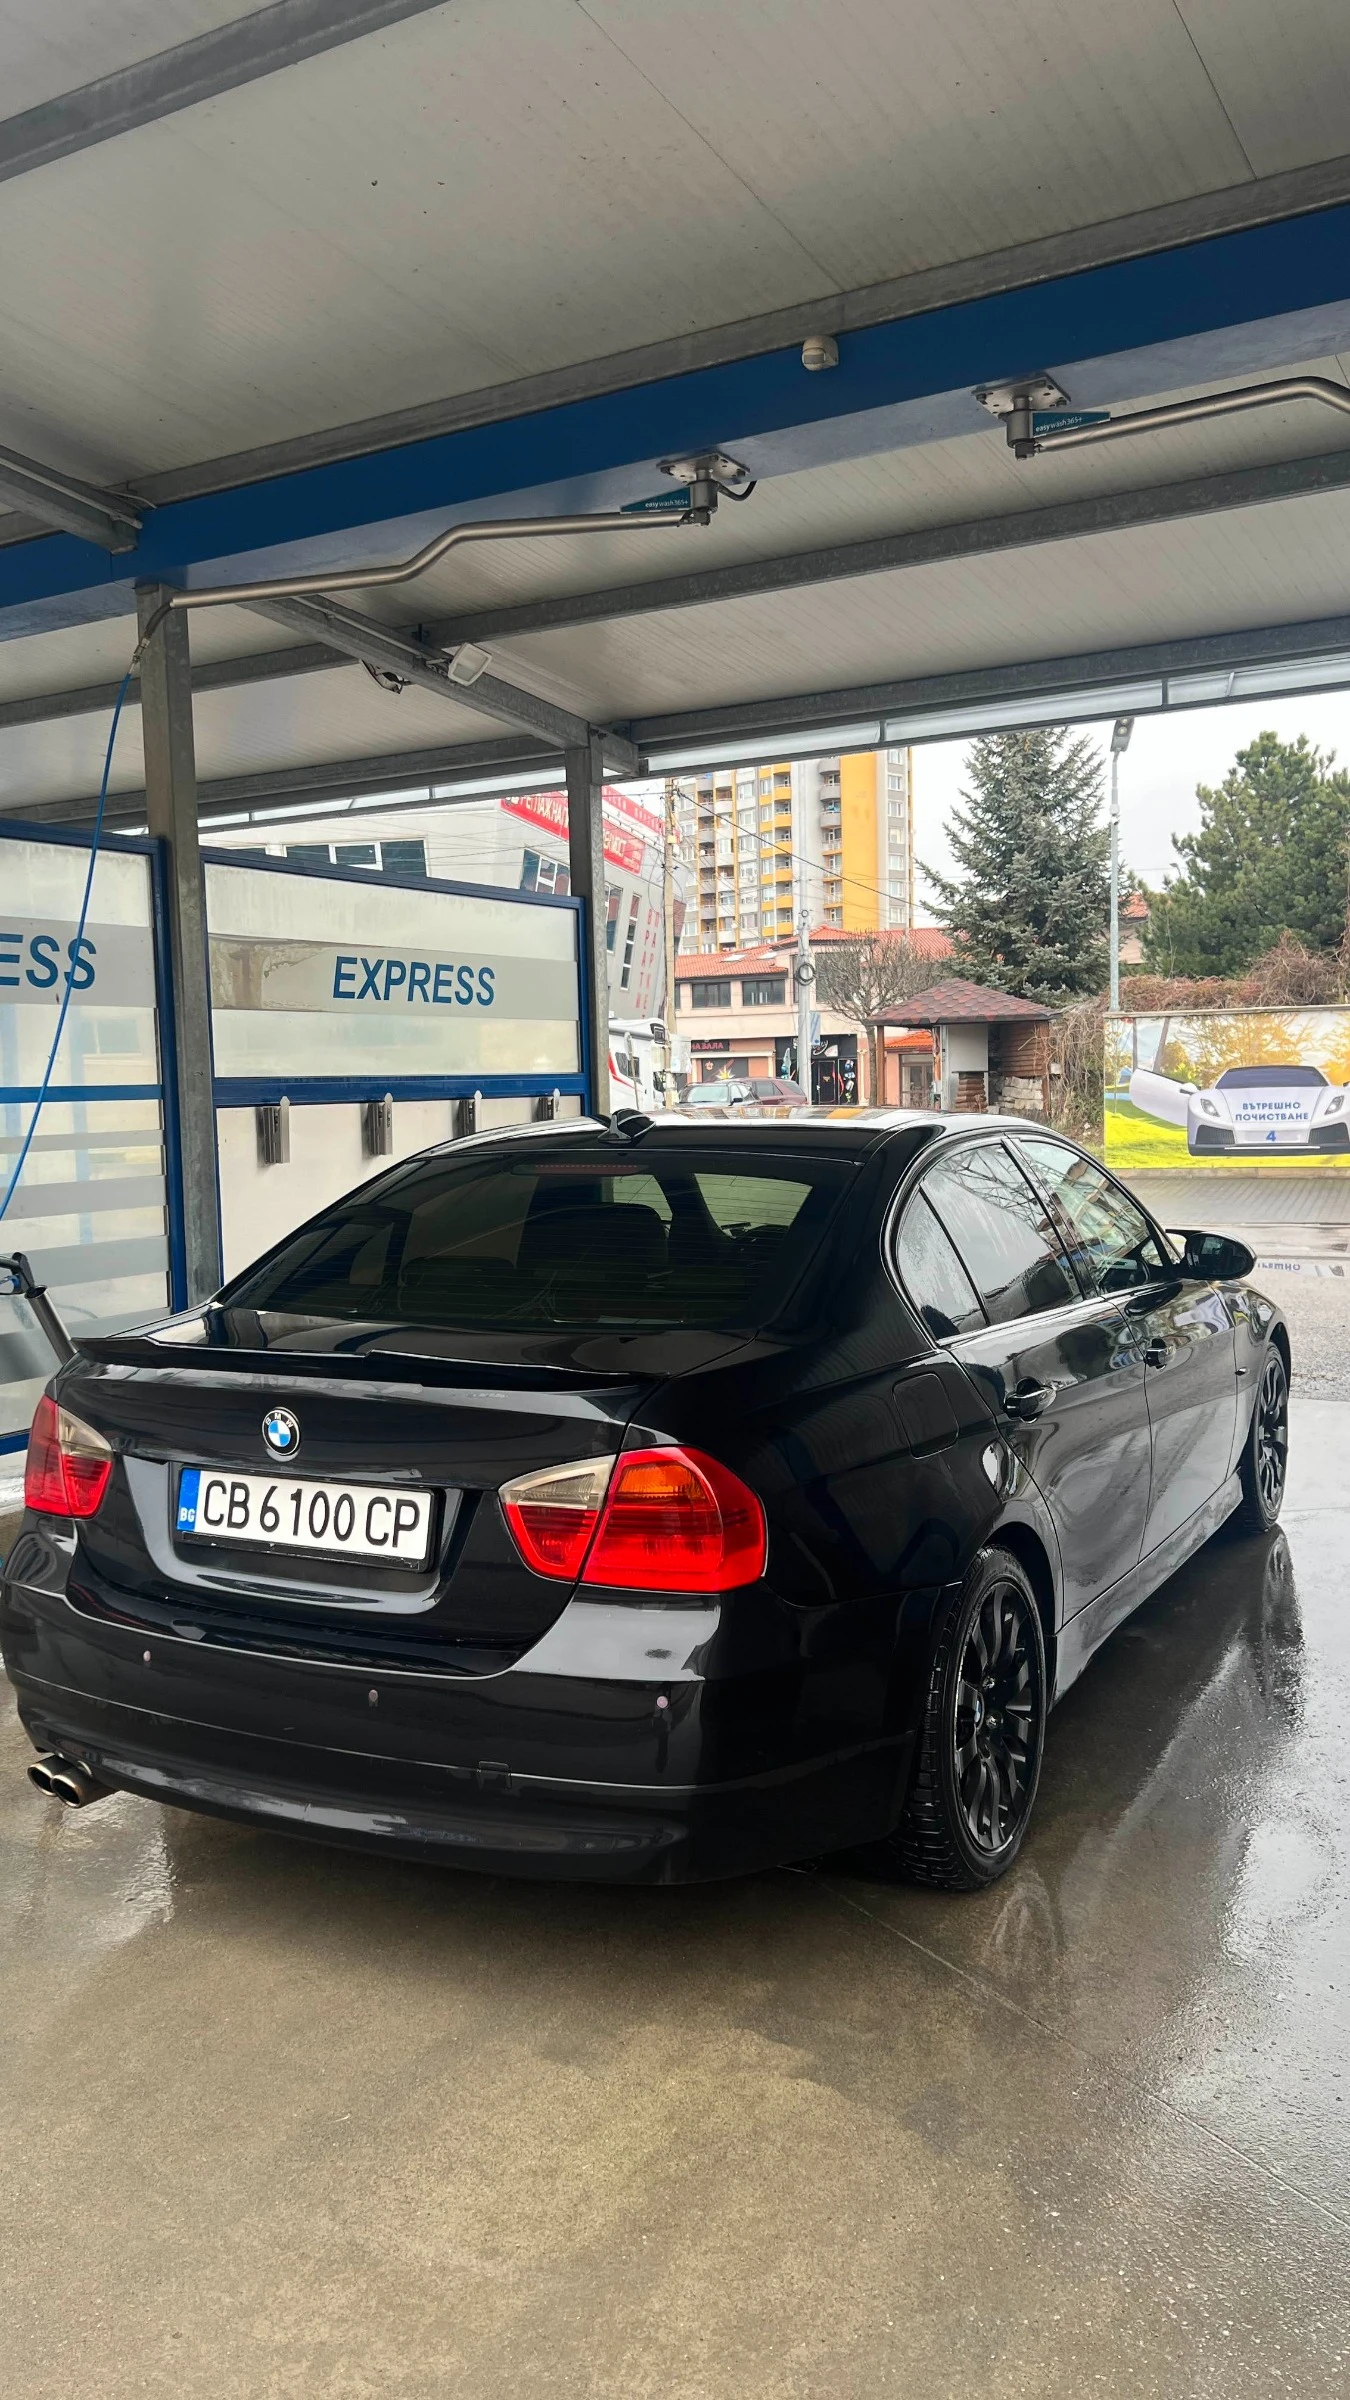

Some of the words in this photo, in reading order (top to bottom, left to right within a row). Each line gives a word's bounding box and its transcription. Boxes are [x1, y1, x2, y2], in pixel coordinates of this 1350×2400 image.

[332, 955, 496, 1006] EXPRESS
[1242, 1101, 1301, 1110] ВЪТРЕШНО
[1235, 1112, 1309, 1121] ПОЧИСТВАНЕ
[1266, 1130, 1277, 1142] 4
[264, 1412, 295, 1428] BMW
[179, 1507, 196, 1523] BG
[259, 1485, 356, 1541] 6100
